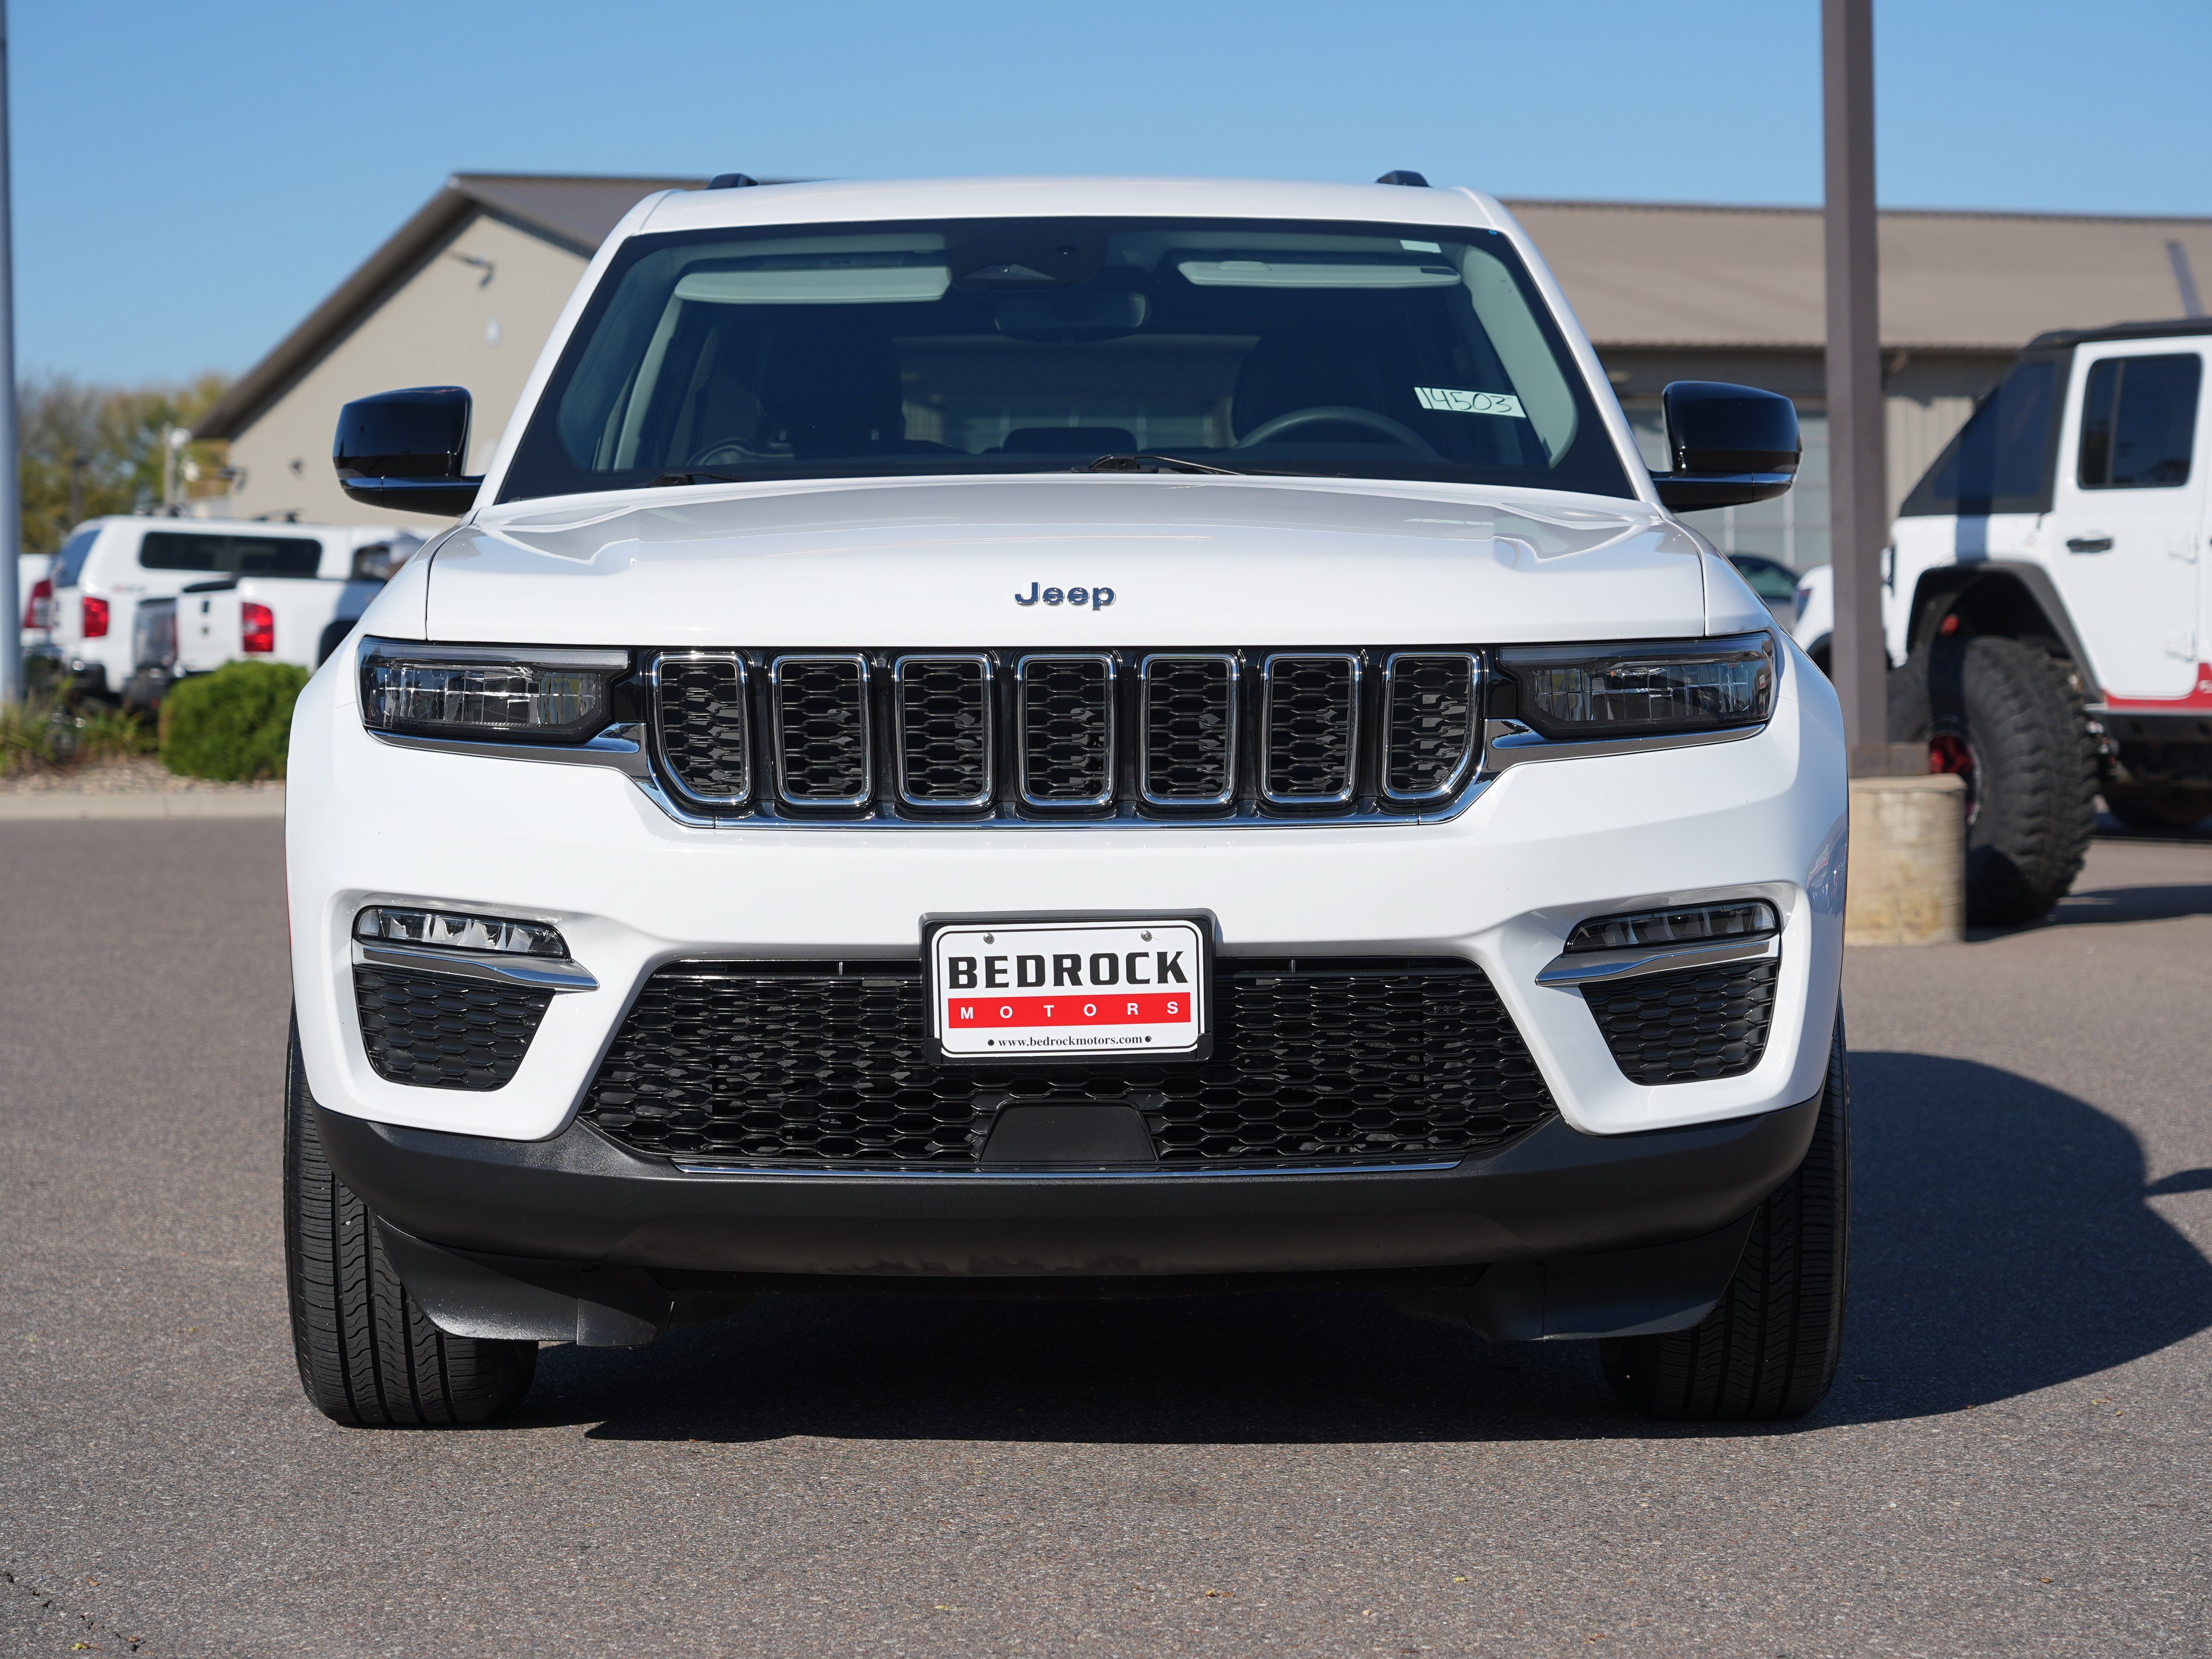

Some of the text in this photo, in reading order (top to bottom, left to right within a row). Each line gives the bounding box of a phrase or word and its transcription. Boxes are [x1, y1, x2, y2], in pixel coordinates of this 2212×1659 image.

[1420, 387, 1512, 413] 14503
[1015, 582, 1116, 611] Jeep
[948, 951, 1189, 989] BEDROCK
[960, 1001, 1178, 1019] MOTORS
[998, 1033, 1142, 1047] www.bedrockmotors.com
